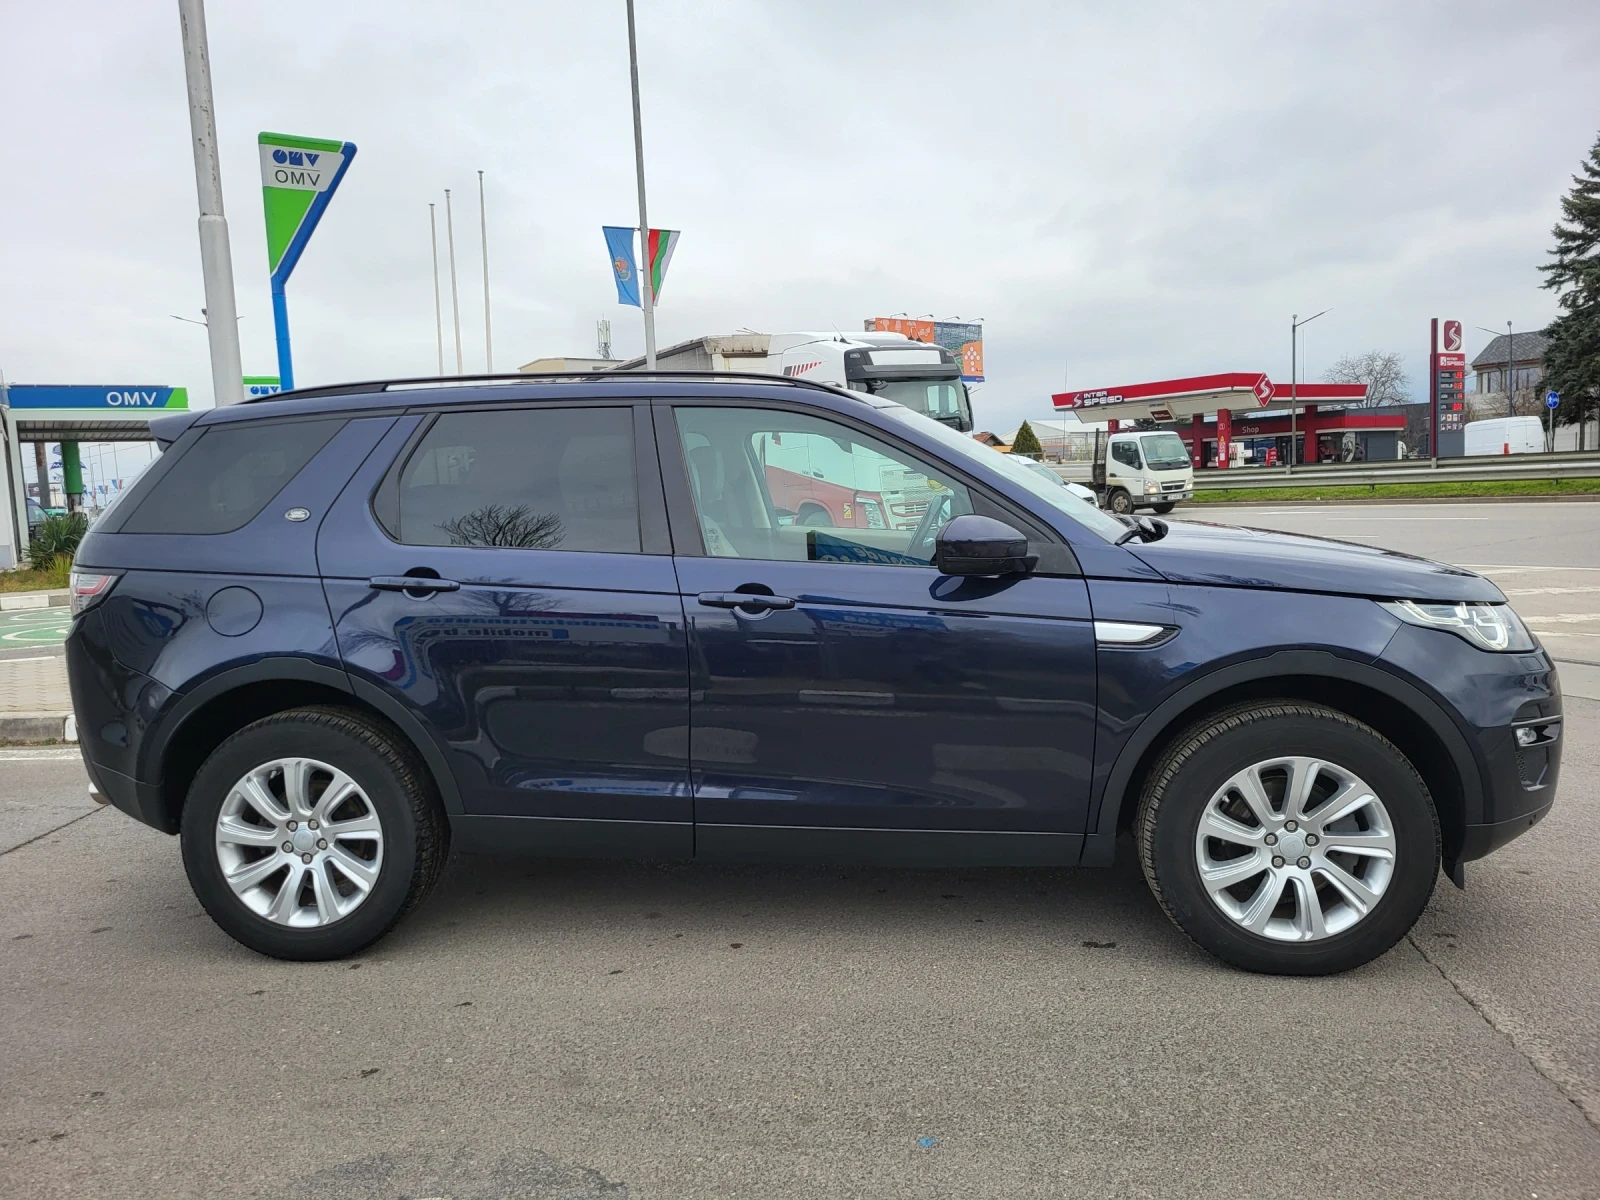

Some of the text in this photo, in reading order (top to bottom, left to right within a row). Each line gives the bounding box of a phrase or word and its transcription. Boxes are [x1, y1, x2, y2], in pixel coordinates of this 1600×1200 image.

[274, 169, 321, 187] OMV
[106, 391, 157, 406] OMV
[1083, 390, 1108, 399] INTER
[1083, 395, 1123, 407] SPEED
[1242, 425, 1260, 434] Shop
